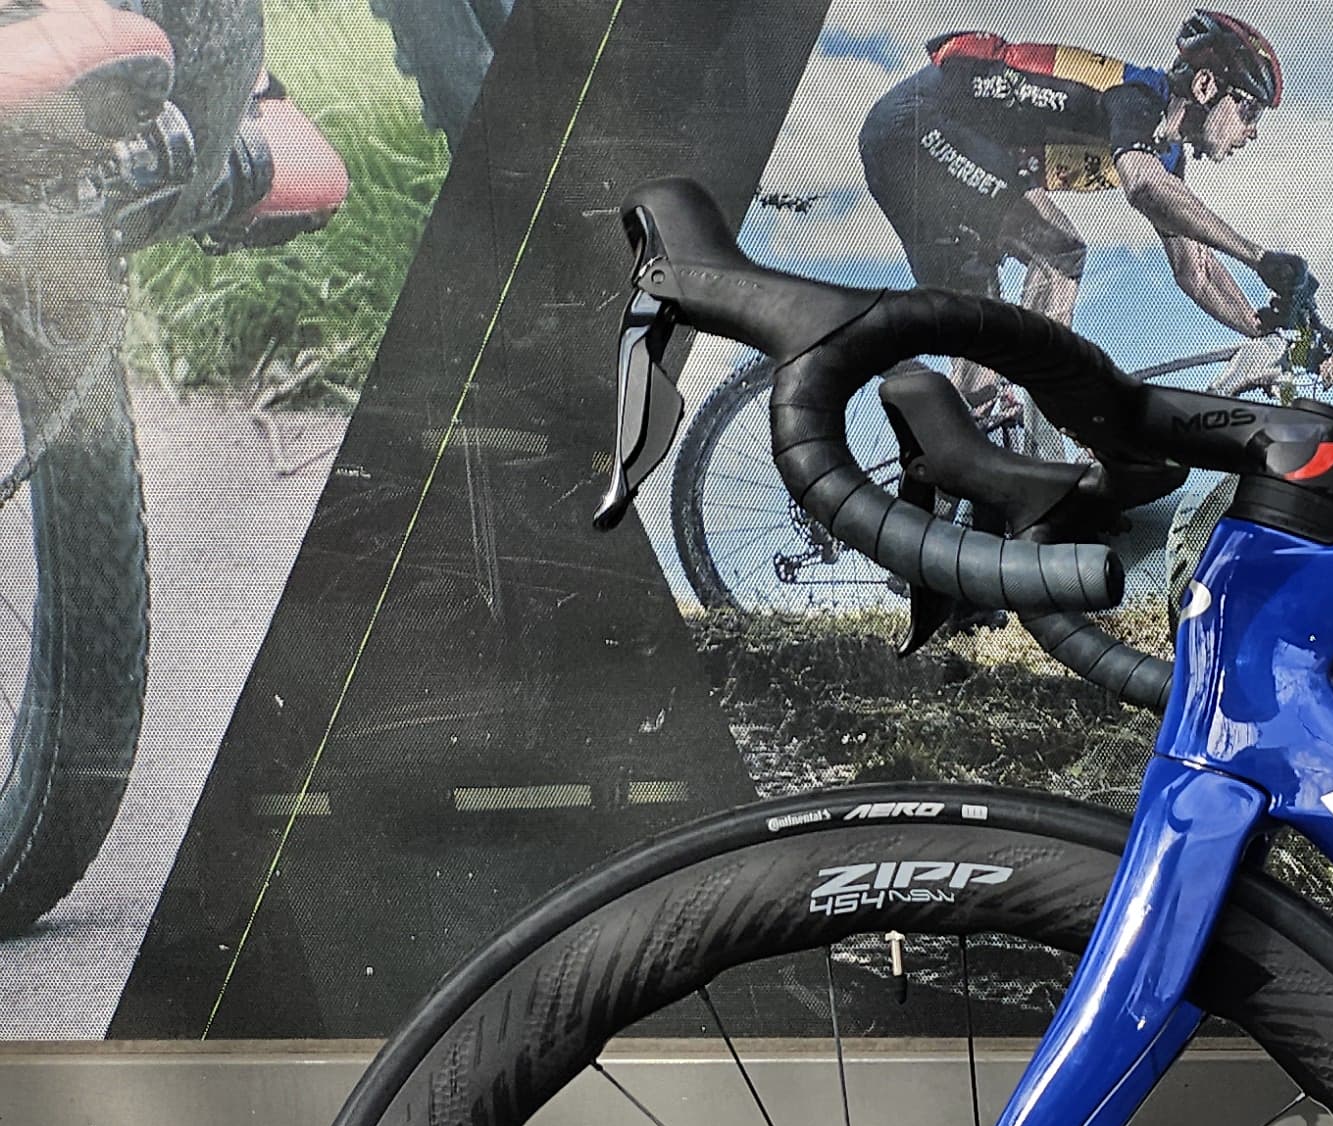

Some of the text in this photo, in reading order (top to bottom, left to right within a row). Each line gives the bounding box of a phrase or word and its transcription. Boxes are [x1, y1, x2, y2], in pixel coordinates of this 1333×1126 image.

[920, 128, 1009, 200] SUPERBET
[767, 809, 823, 833] Continental
[843, 802, 945, 820] AERO
[811, 860, 1014, 898] ZIPP
[809, 889, 955, 916] 454 NSW
